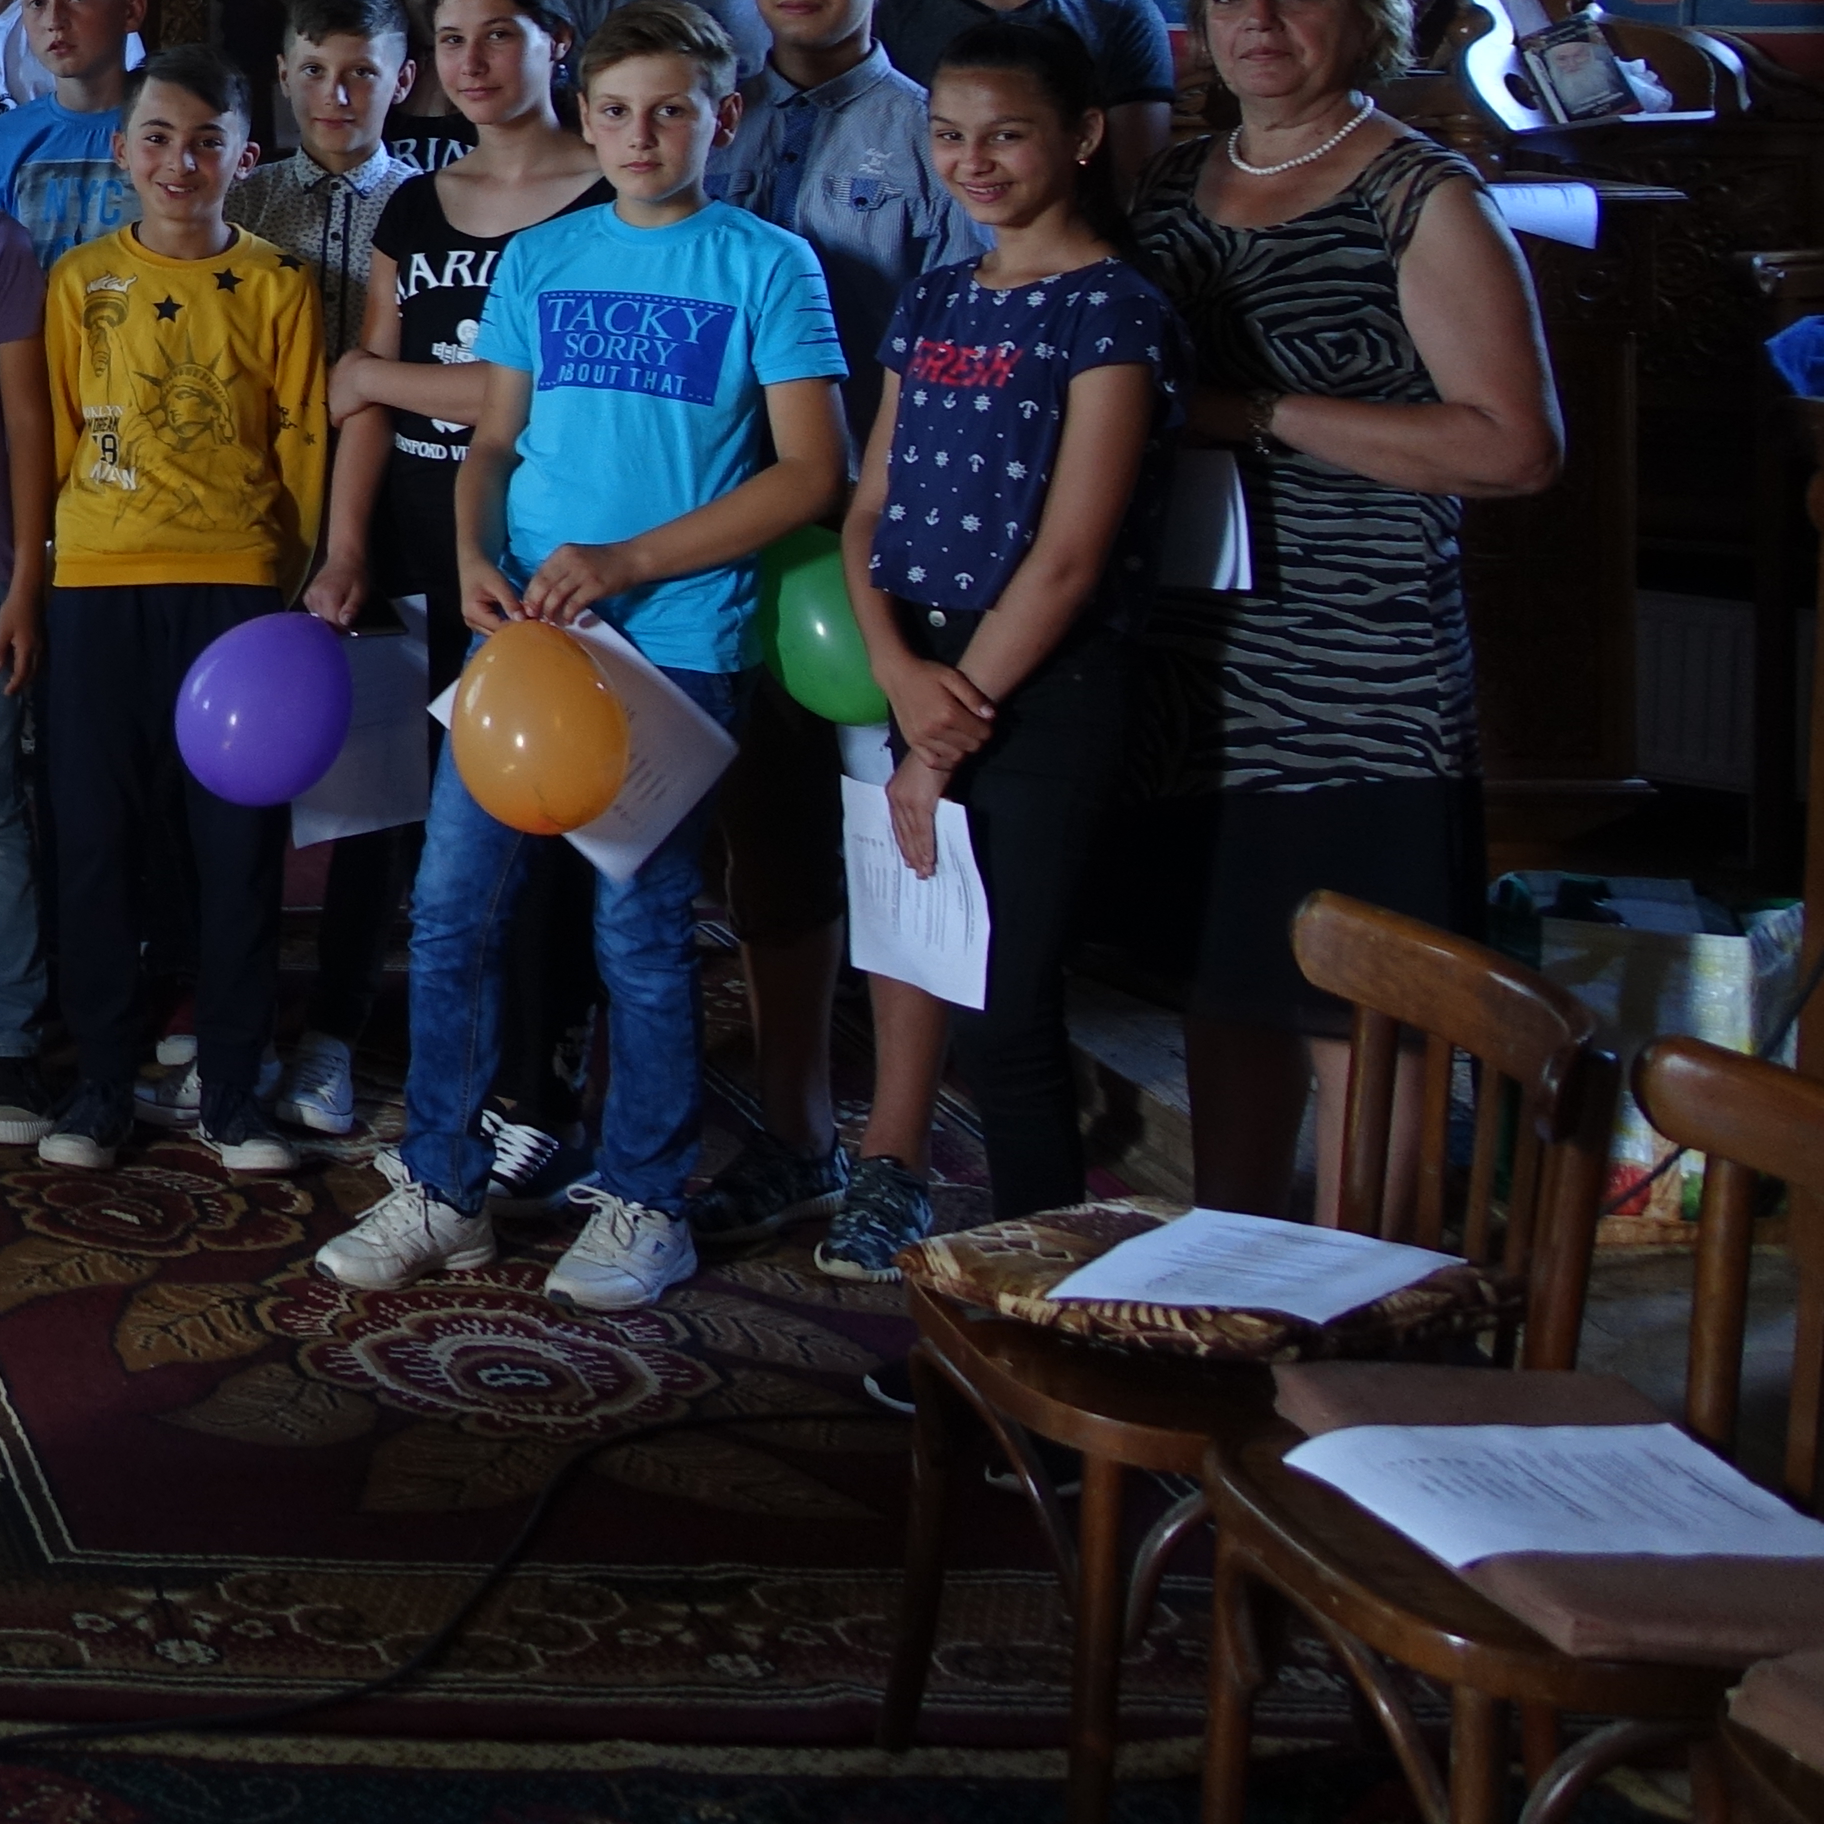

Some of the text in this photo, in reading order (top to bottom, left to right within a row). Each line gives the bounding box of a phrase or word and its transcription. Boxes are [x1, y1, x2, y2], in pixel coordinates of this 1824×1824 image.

[44, 177, 123, 225] NYC
[546, 298, 721, 345] TACKY
[564, 332, 680, 367] SORRY
[629, 367, 688, 396] THAT
